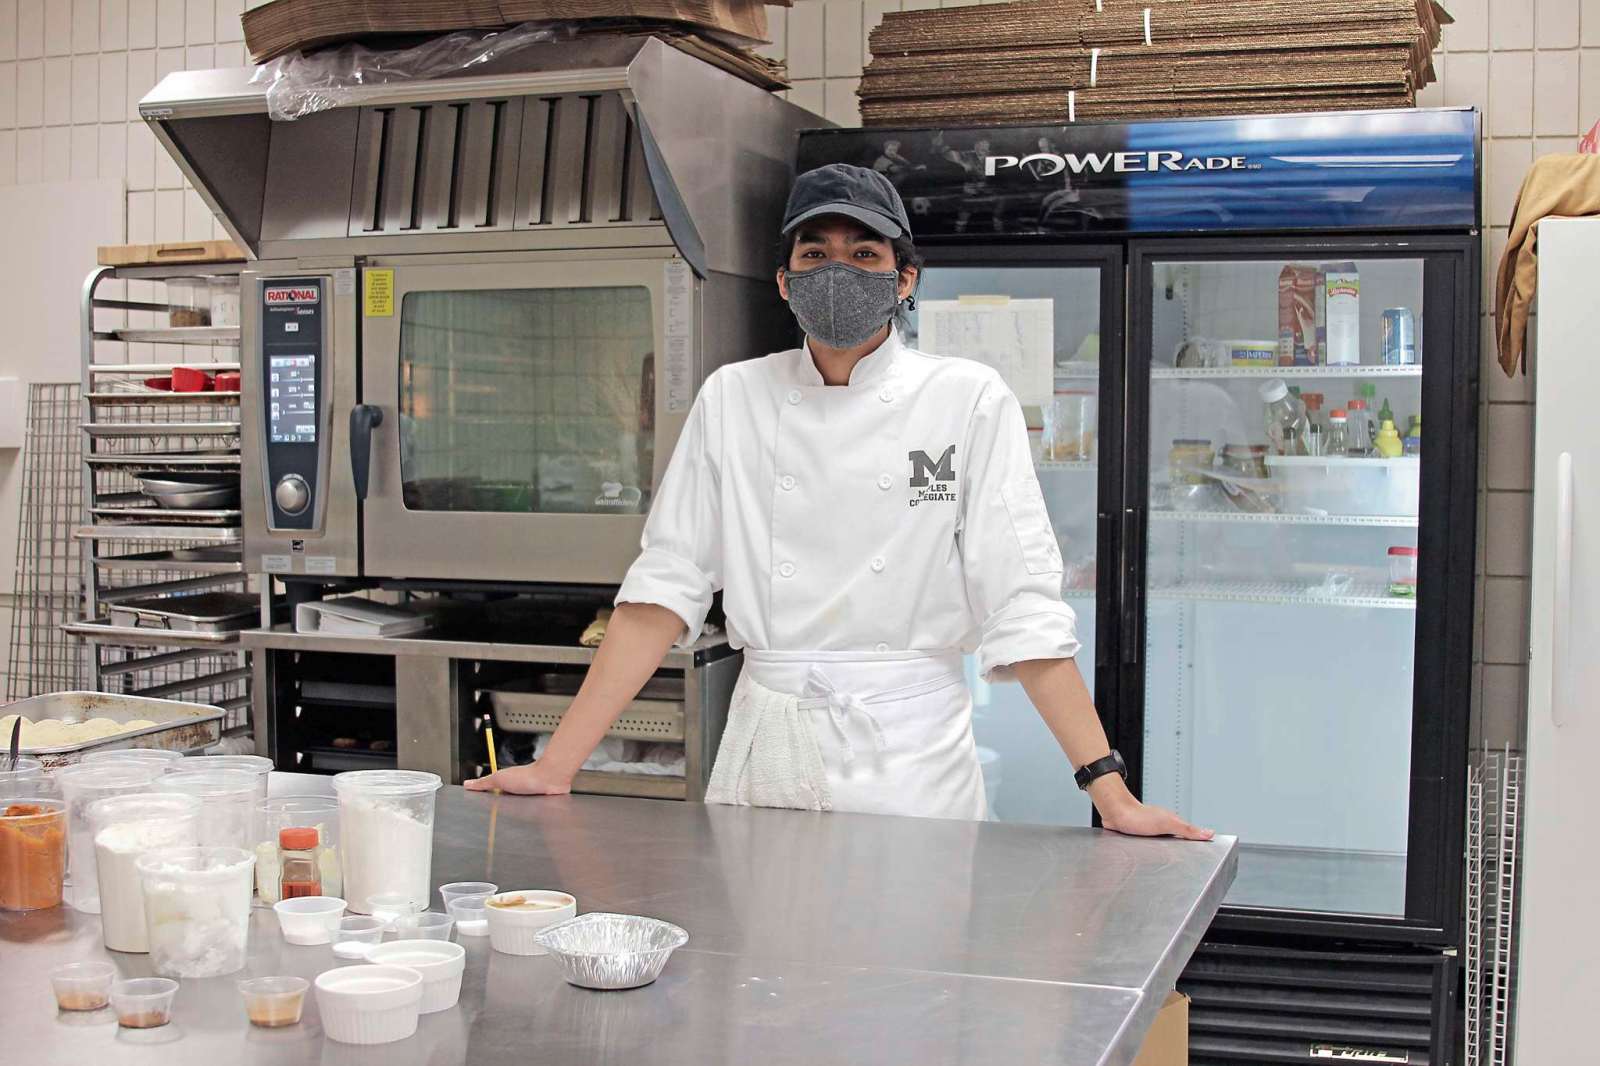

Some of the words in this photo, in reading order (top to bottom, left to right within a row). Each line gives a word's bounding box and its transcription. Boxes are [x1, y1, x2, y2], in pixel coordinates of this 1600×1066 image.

[985, 151, 1247, 176] POWERADE
[267, 289, 316, 301] RATIONAL
[909, 444, 955, 487] M
[909, 493, 956, 506] COEGIATE
